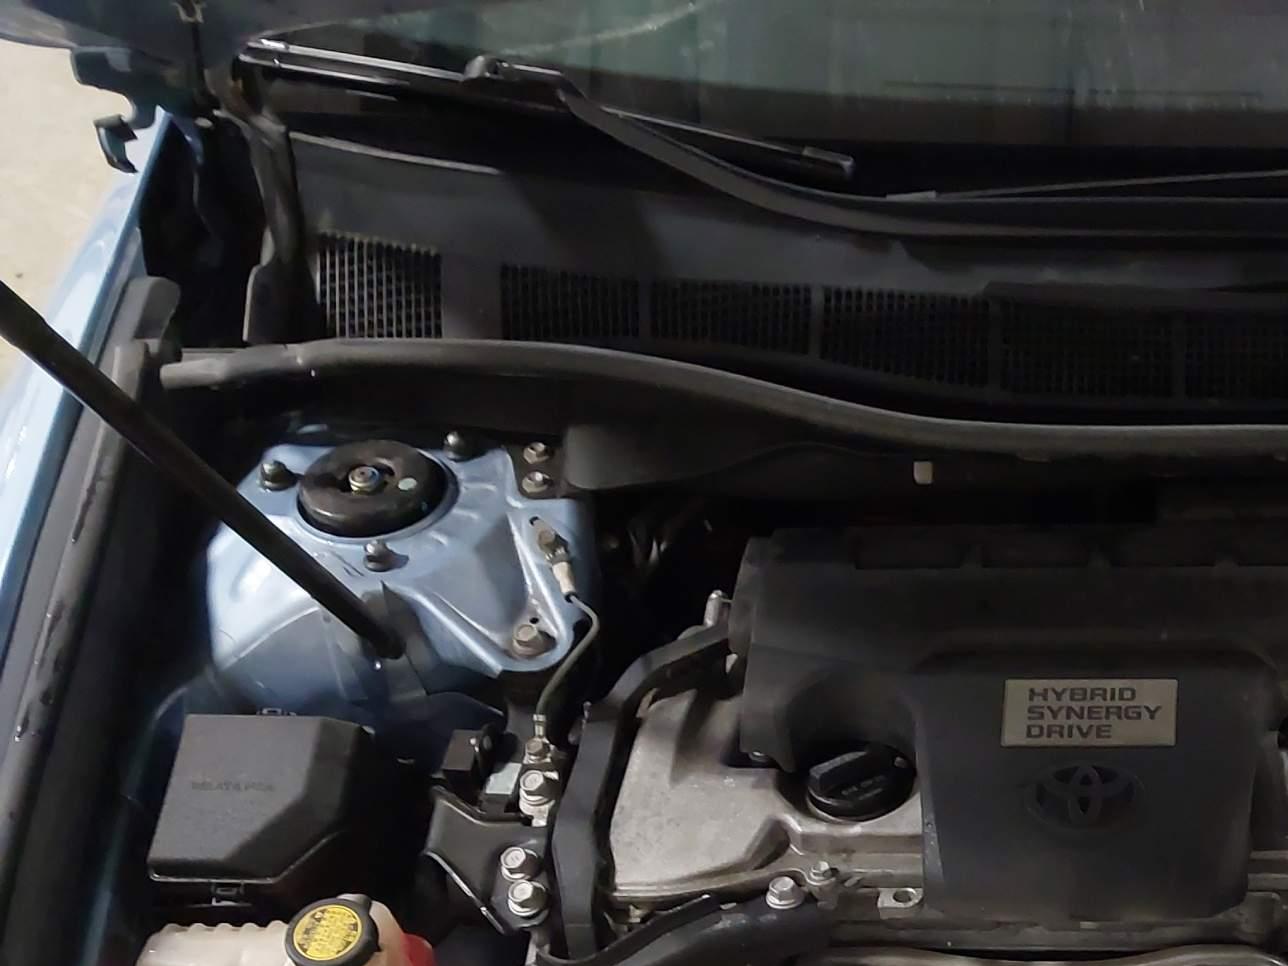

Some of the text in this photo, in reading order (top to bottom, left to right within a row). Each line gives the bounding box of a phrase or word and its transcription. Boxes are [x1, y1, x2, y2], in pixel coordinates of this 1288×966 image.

[1028, 687, 1137, 702] HYBRID
[1027, 705, 1162, 721] SYNERGY
[1025, 724, 1113, 739] DRIVE
